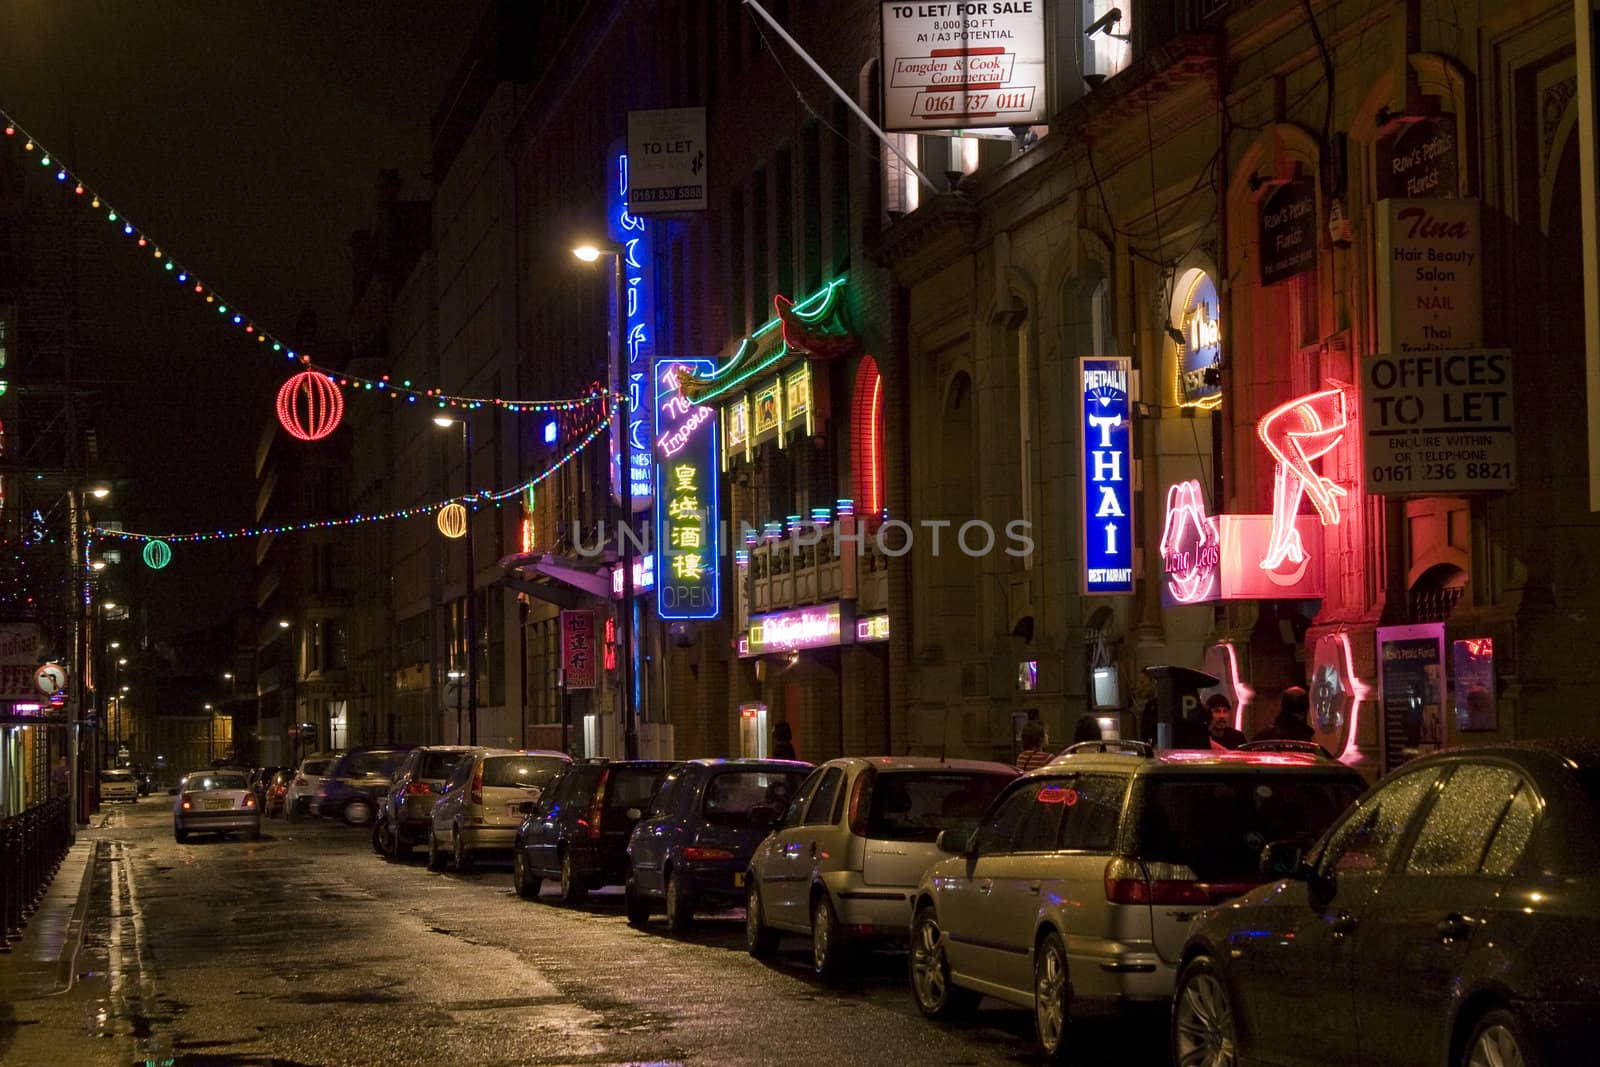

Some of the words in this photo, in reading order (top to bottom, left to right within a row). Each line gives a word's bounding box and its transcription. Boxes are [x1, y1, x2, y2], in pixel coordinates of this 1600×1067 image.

[893, 6, 913, 19] TO
[918, 4, 951, 18] LET/
[956, 3, 988, 16] FOR
[993, 1, 1033, 14] SALE
[933, 20, 960, 30] 8,000
[963, 19, 979, 29] SQ
[981, 18, 995, 28] FT
[916, 33, 928, 42] A1
[937, 32, 951, 42] A3
[954, 30, 1014, 41] POTENTIAL
[897, 59, 947, 76] Longden
[953, 60, 965, 71] &
[969, 56, 1001, 69] Cook
[931, 69, 1005, 84] Commercial
[925, 96, 955, 112] 0161
[966, 94, 989, 110] 737
[996, 93, 1026, 109] 0111
[641, 142, 661, 154] TO
[666, 140, 694, 154] LET
[1397, 207, 1470, 239] Tina
[1394, 248, 1423, 262] Hair
[1427, 248, 1476, 266] Beauty
[1416, 266, 1456, 281] Salon
[619, 154, 648, 450] acific
[1417, 296, 1455, 310] NAIL
[1422, 326, 1452, 339] Thai
[1371, 354, 1506, 389] OFFICES
[1372, 395, 1424, 426] TO
[1442, 391, 1507, 423] LET
[1447, 435, 1492, 447] WITHIN
[1372, 465, 1412, 482] 0161
[1422, 463, 1456, 480] 236
[1466, 462, 1511, 479] 8821
[1088, 412, 1125, 554] THAI
[1088, 568, 1132, 583] RESTAURANT
[661, 585, 715, 608] OPEN
[1182, 695, 1197, 720] P
